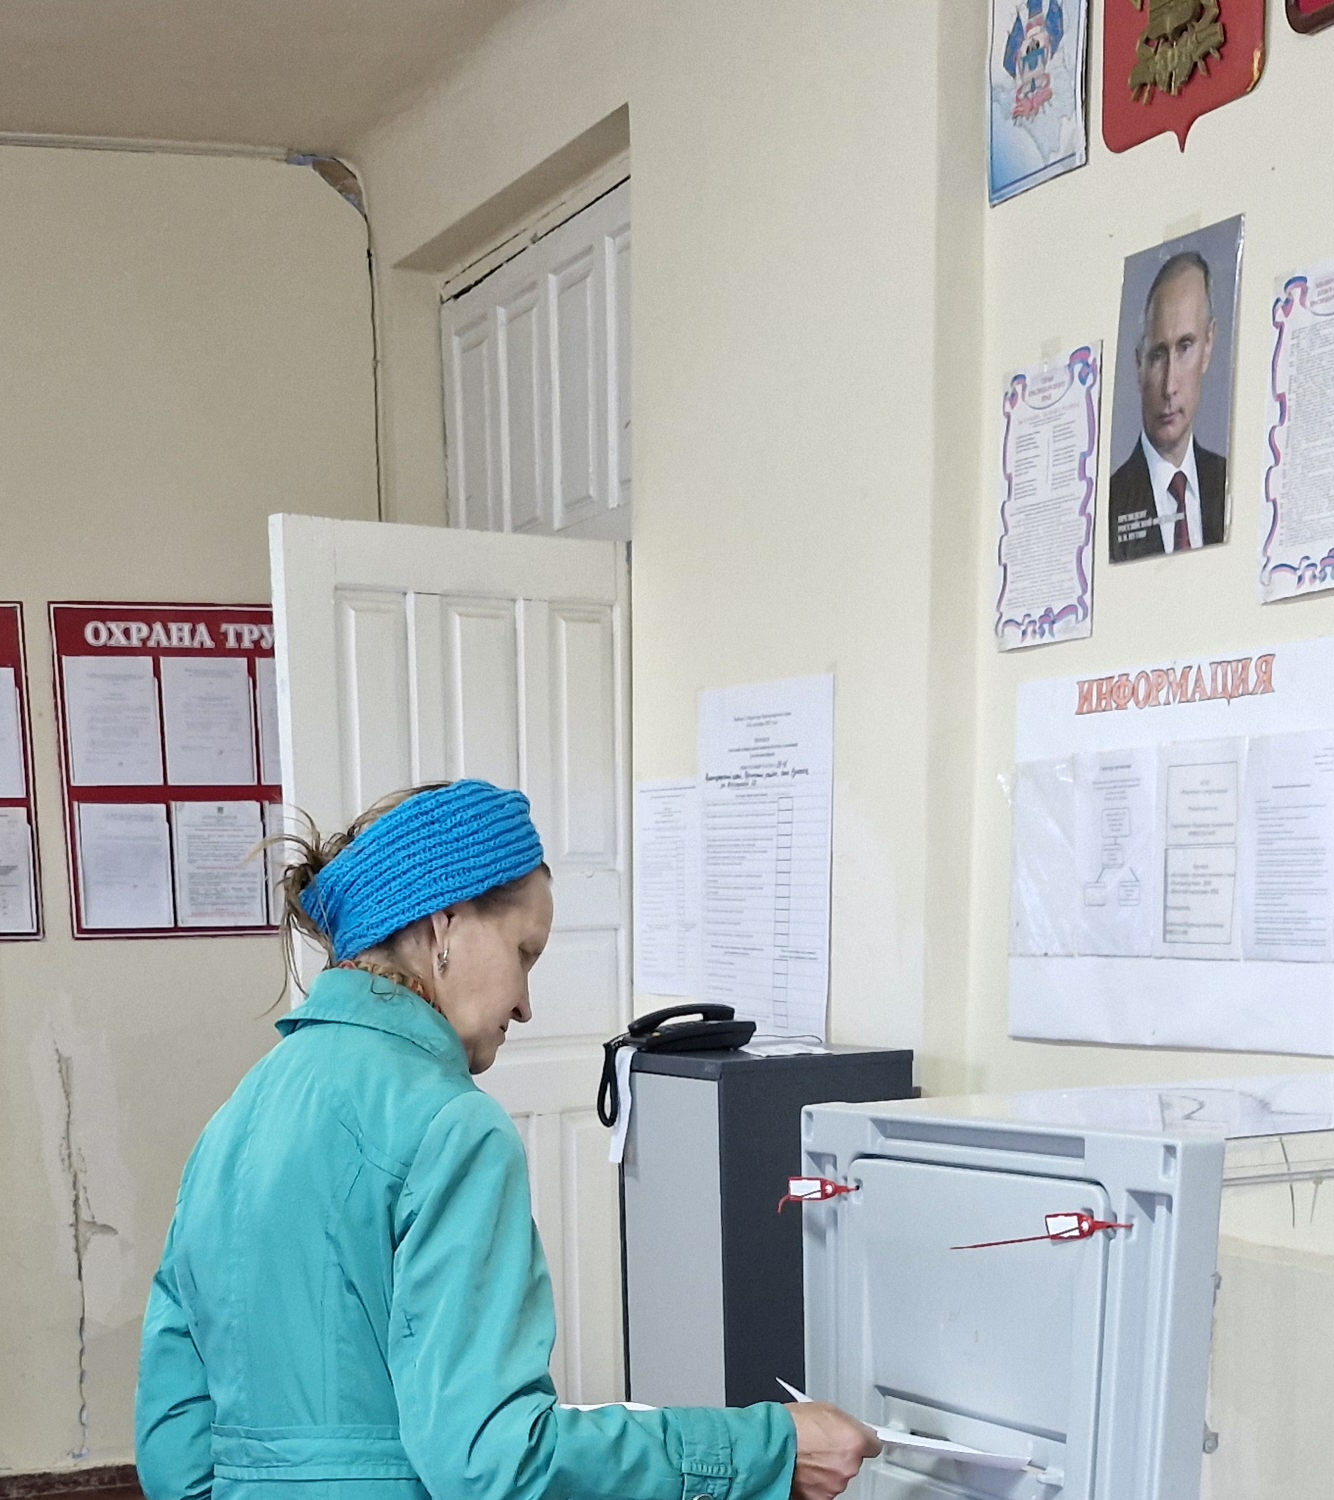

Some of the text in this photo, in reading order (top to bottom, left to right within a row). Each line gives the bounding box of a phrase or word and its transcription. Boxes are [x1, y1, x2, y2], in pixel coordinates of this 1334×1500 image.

[84, 620, 275, 649] ОХРАНА ТРУ
[1075, 654, 1276, 716] ИНФОРМАЦИЯ
